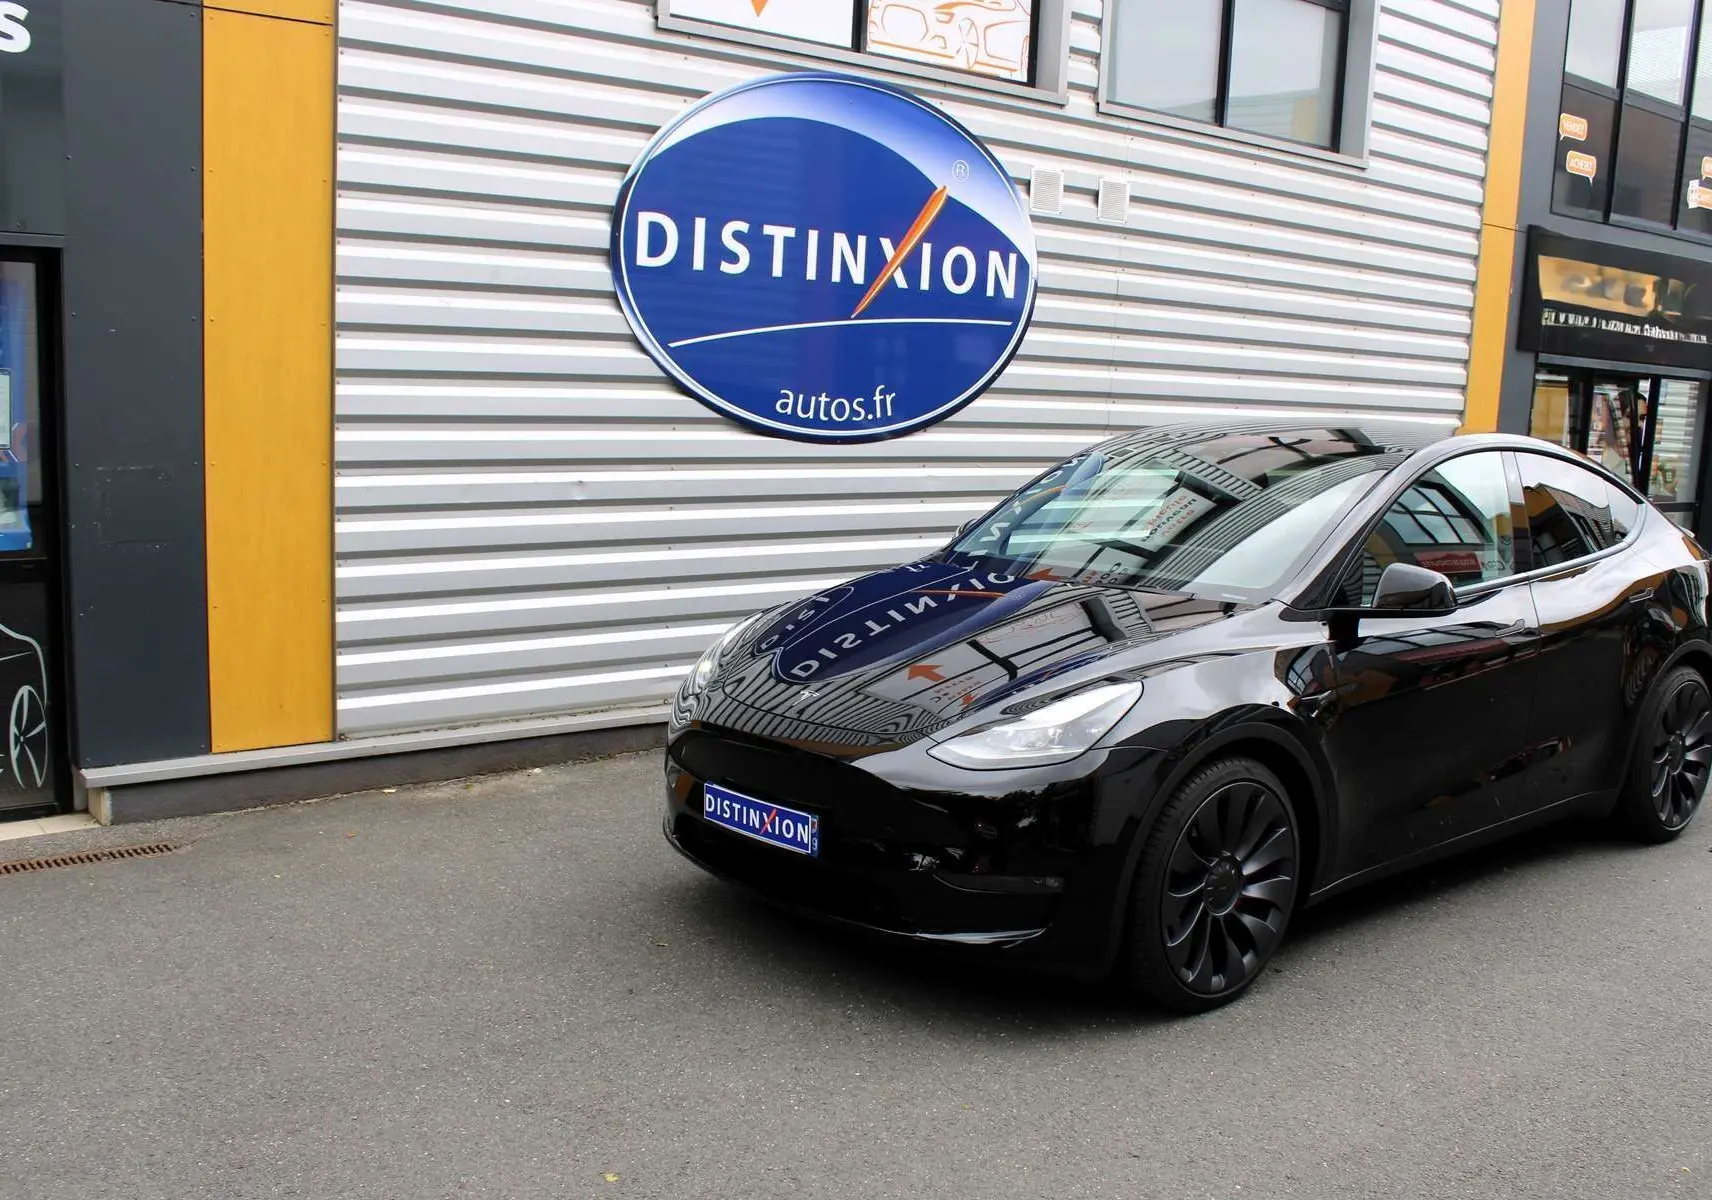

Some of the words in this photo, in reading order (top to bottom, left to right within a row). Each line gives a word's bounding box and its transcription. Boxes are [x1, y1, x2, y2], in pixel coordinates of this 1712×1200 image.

[635, 188, 1018, 315] DISTINXION
[774, 384, 896, 422] autos.fr
[705, 793, 809, 844] DISTINXION
